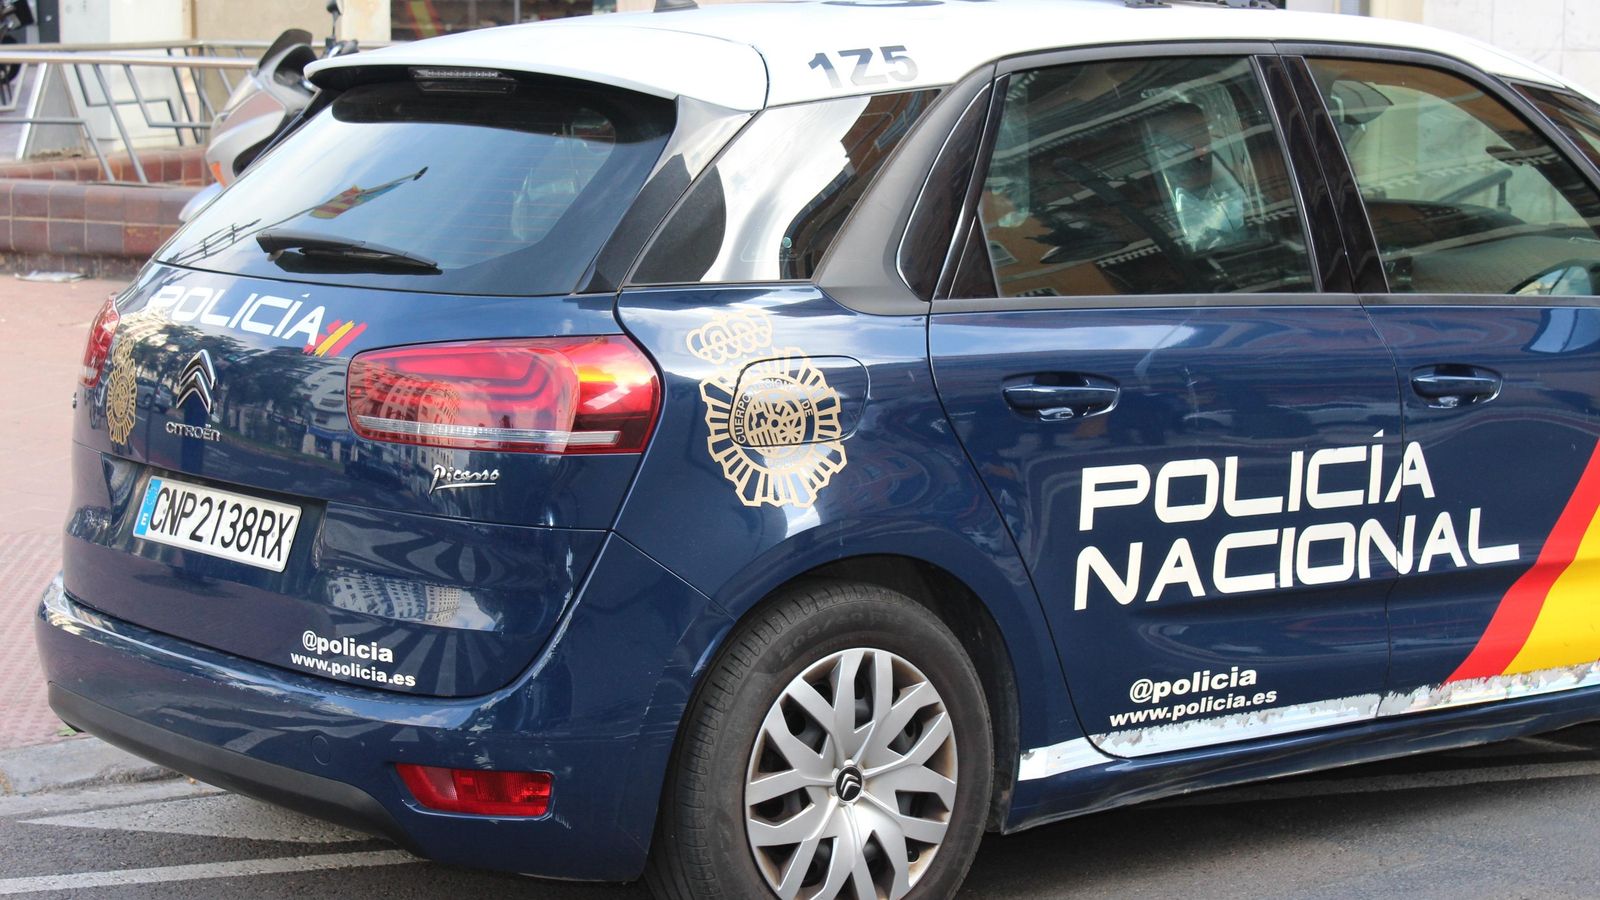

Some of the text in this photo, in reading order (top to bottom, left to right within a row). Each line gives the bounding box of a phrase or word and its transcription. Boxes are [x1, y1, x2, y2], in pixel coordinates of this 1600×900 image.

[807, 45, 919, 88] 1Z5
[149, 285, 326, 346] POLICÍA
[165, 424, 222, 443] CITROËN
[734, 392, 752, 444] CUERPO
[801, 400, 814, 417] DE
[428, 464, 500, 495] Picasso
[1079, 429, 1436, 531] POLICÍA
[140, 512, 149, 526] E
[150, 487, 295, 562] CNP2138RX
[1073, 507, 1521, 611] NACIONAL
[302, 630, 394, 664] @policia
[290, 652, 417, 687] www.policia.es
[1129, 666, 1258, 704] @policia
[1109, 690, 1278, 727] www.policia.es
